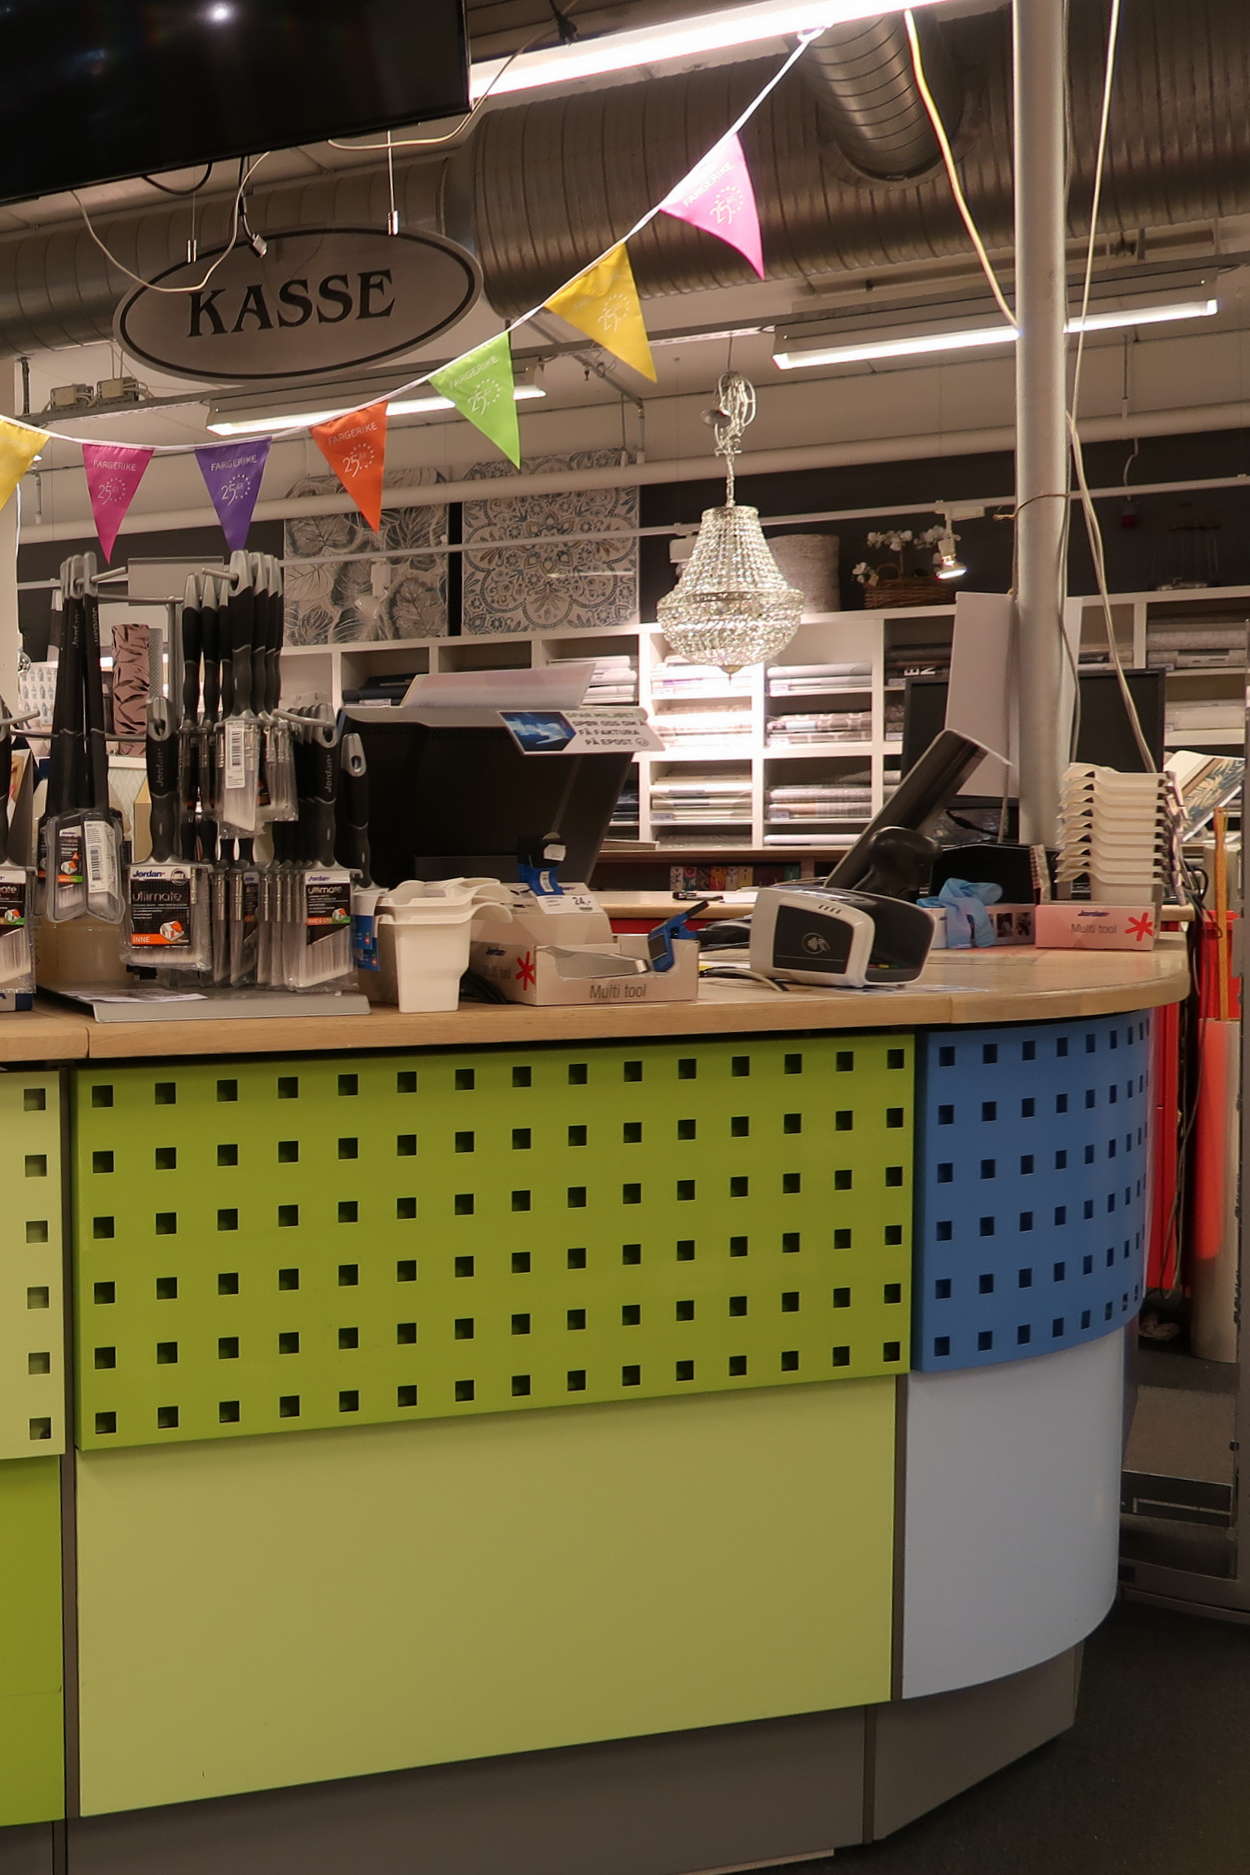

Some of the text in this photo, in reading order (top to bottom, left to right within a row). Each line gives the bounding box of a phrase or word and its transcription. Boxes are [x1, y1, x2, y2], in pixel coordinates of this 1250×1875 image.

[683, 160, 735, 208] FARGERIKE
[710, 199, 734, 225] 25
[187, 268, 396, 338] KASSE
[449, 355, 499, 389] FARGERIKE
[467, 390, 486, 415] 25
[327, 421, 377, 446] FARGERIKE
[93, 459, 137, 472] FARGERIKE
[210, 454, 258, 471] FARGERIKE
[342, 453, 360, 478] 25
[98, 484, 113, 506] 25
[221, 483, 236, 506] 25
[156, 752, 164, 787] Jordan
[325, 758, 333, 793] Jordan
[133, 870, 162, 878] Jordan
[1071, 924, 1117, 933] Multi tool
[589, 983, 647, 999] Multi tool
